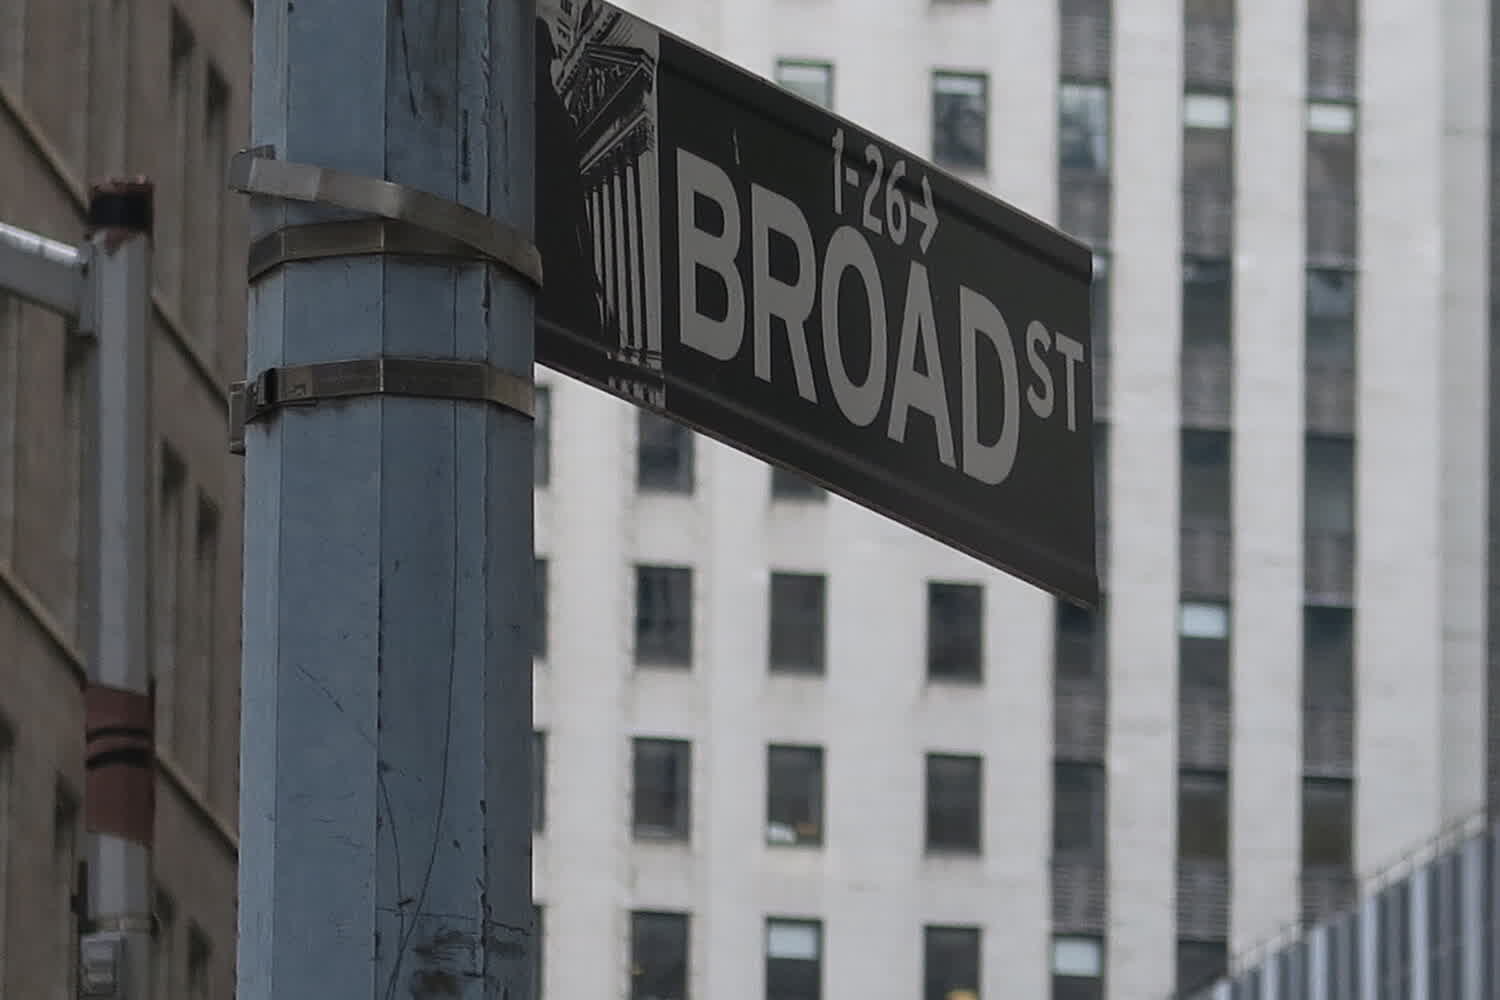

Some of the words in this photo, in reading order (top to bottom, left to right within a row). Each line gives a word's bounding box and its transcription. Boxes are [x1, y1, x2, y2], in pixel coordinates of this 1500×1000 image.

[831, 127, 907, 246] 1-26
[676, 147, 1020, 486] BROAD
[1025, 319, 1085, 433] ST
